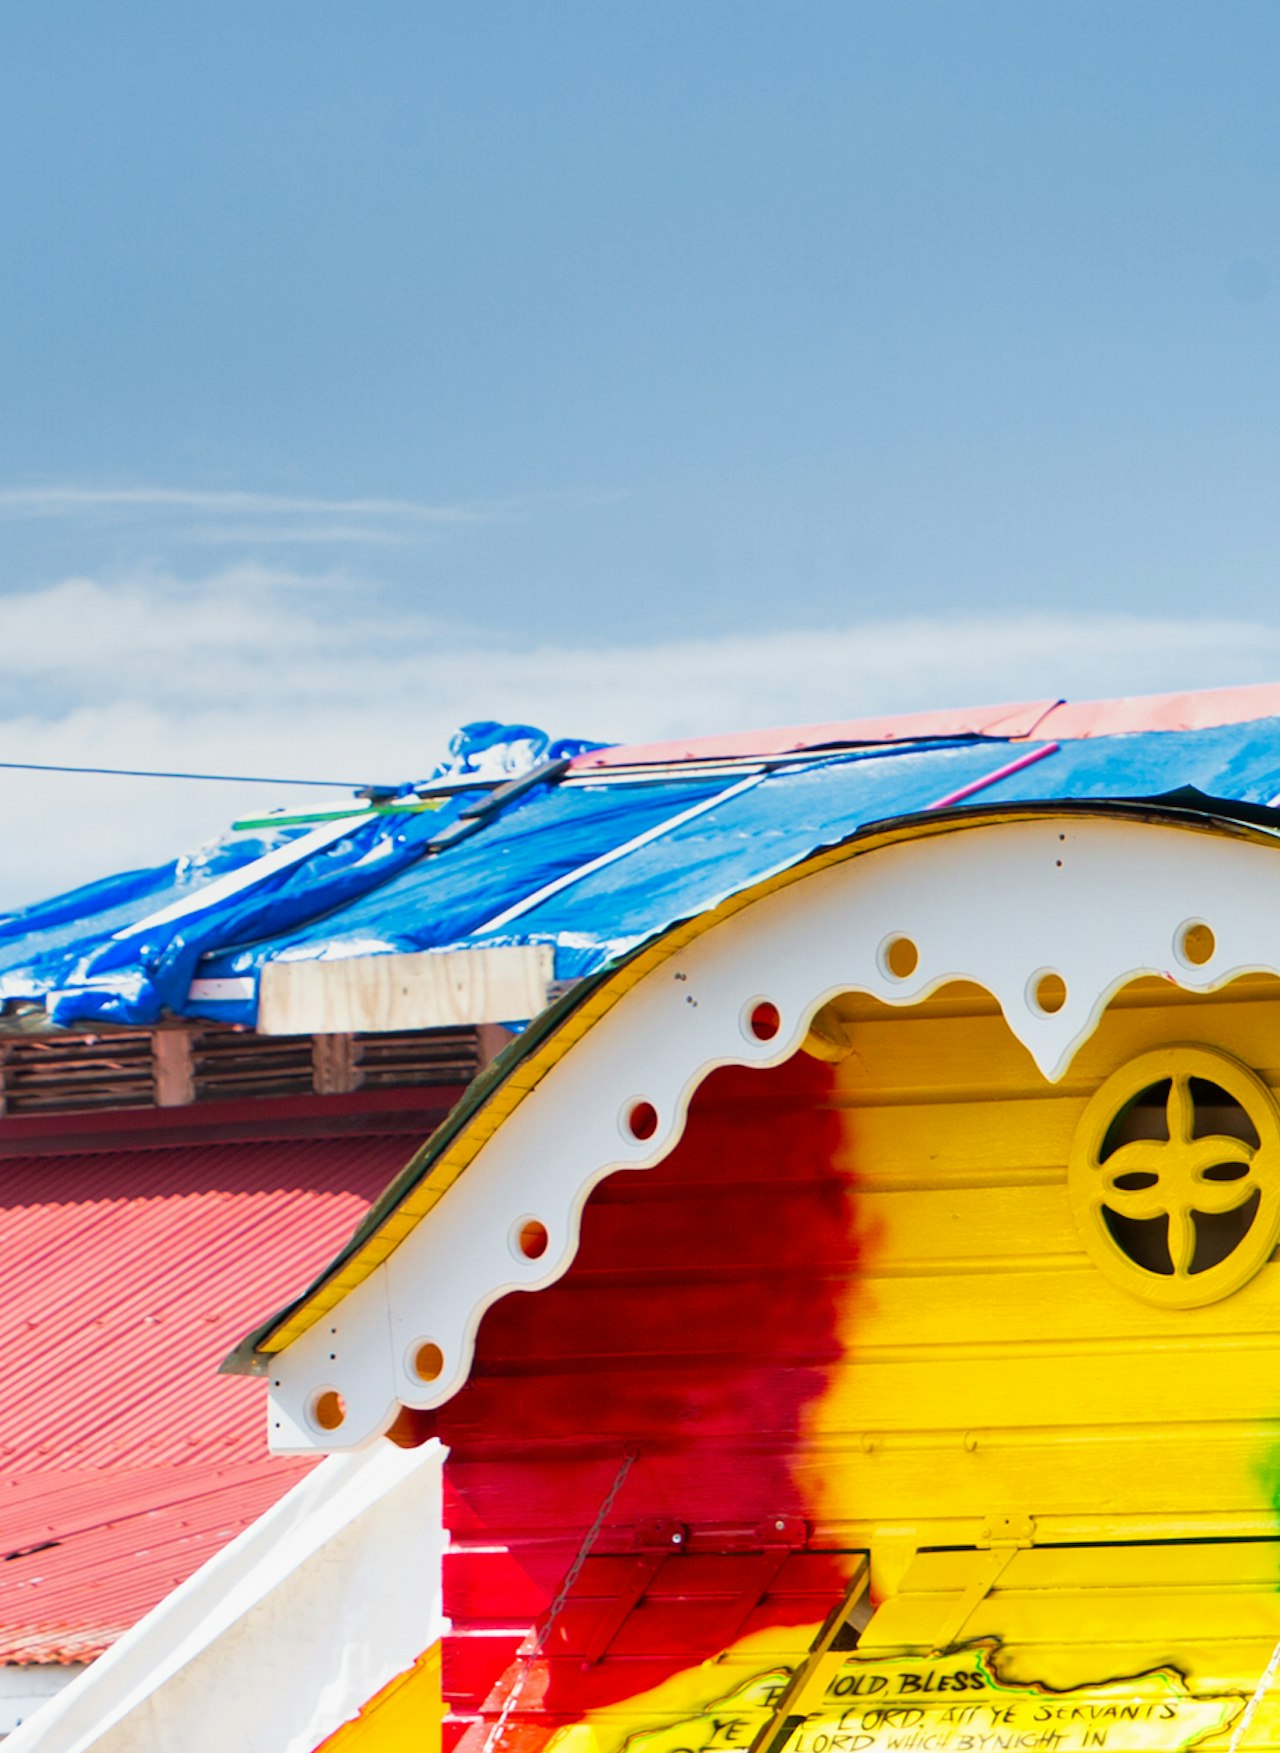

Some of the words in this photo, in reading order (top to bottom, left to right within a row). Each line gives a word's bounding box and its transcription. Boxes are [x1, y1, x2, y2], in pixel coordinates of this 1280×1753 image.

[897, 1669, 988, 1693] BLESS
[711, 1717, 751, 1744] YE
[837, 1707, 925, 1732] LORD.
